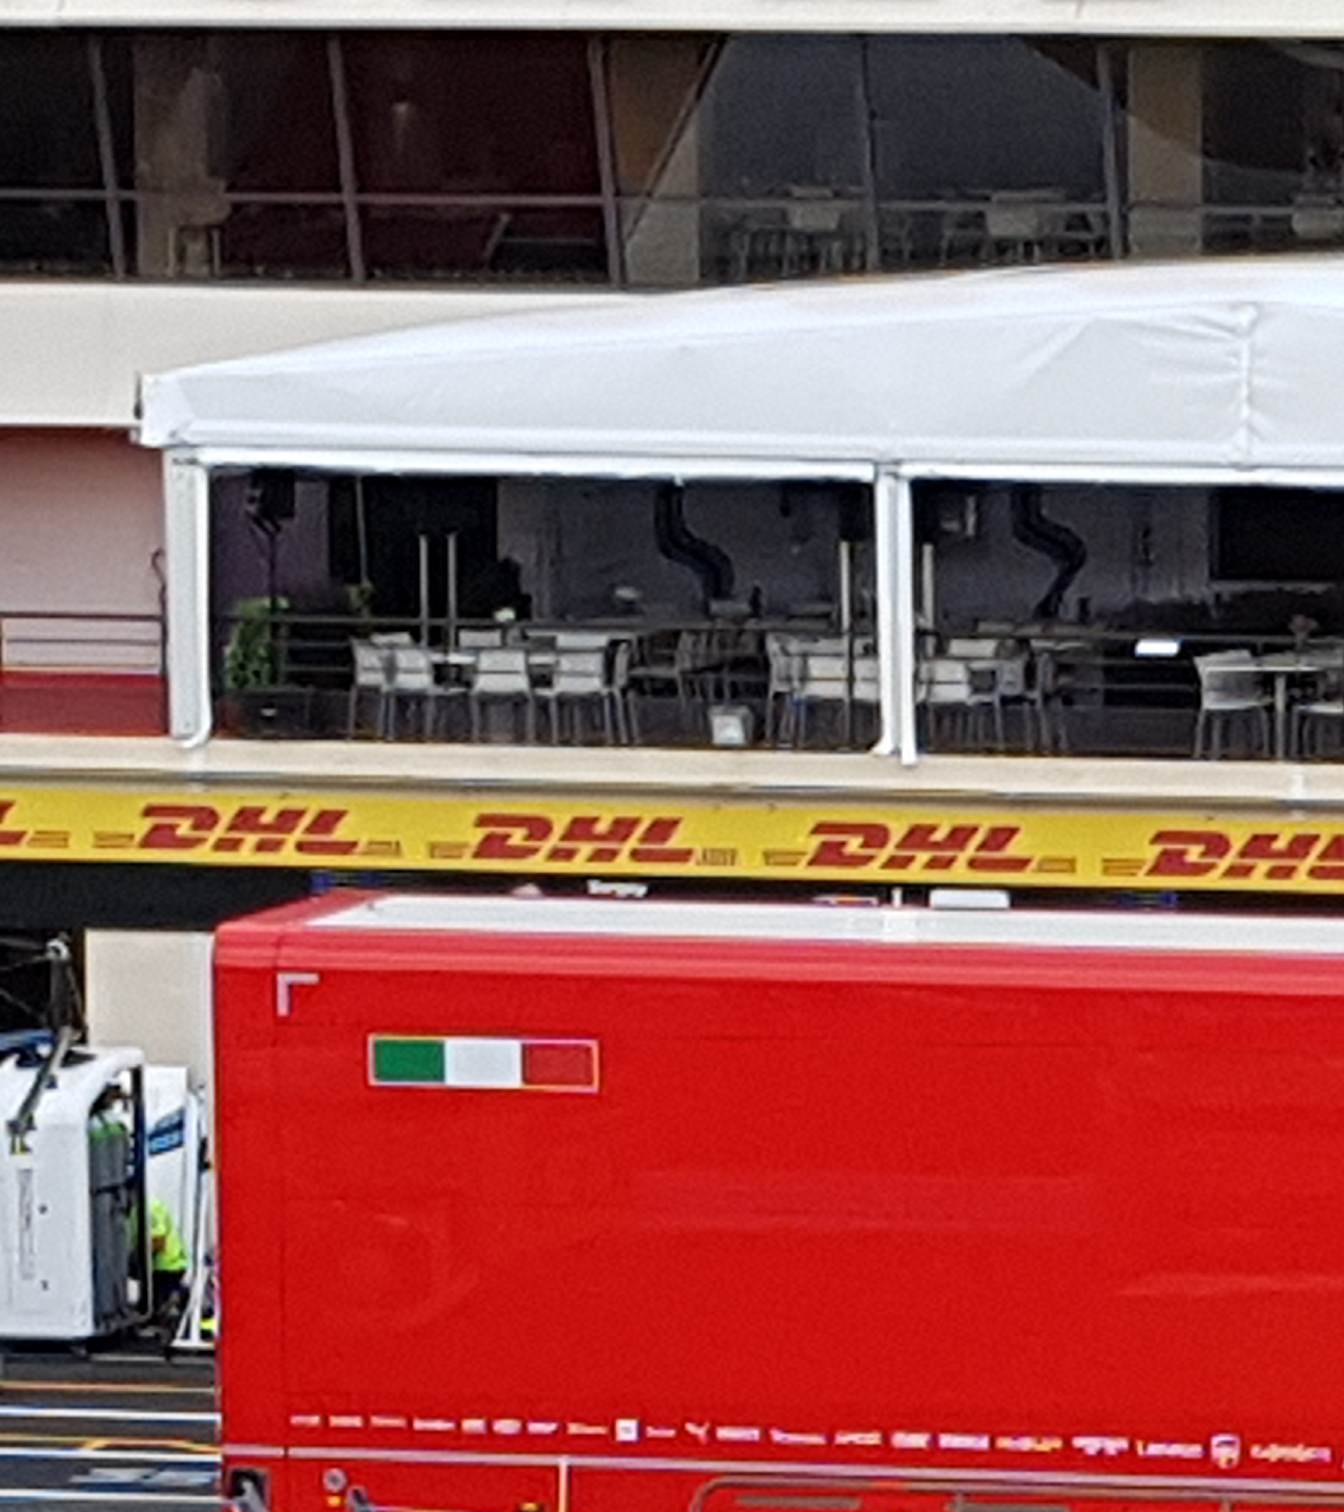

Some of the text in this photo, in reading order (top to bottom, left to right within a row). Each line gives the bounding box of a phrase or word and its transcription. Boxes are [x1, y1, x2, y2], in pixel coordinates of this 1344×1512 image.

[139, 805, 360, 855] DHL
[473, 814, 695, 863] DHL
[807, 822, 1034, 871] DHL
